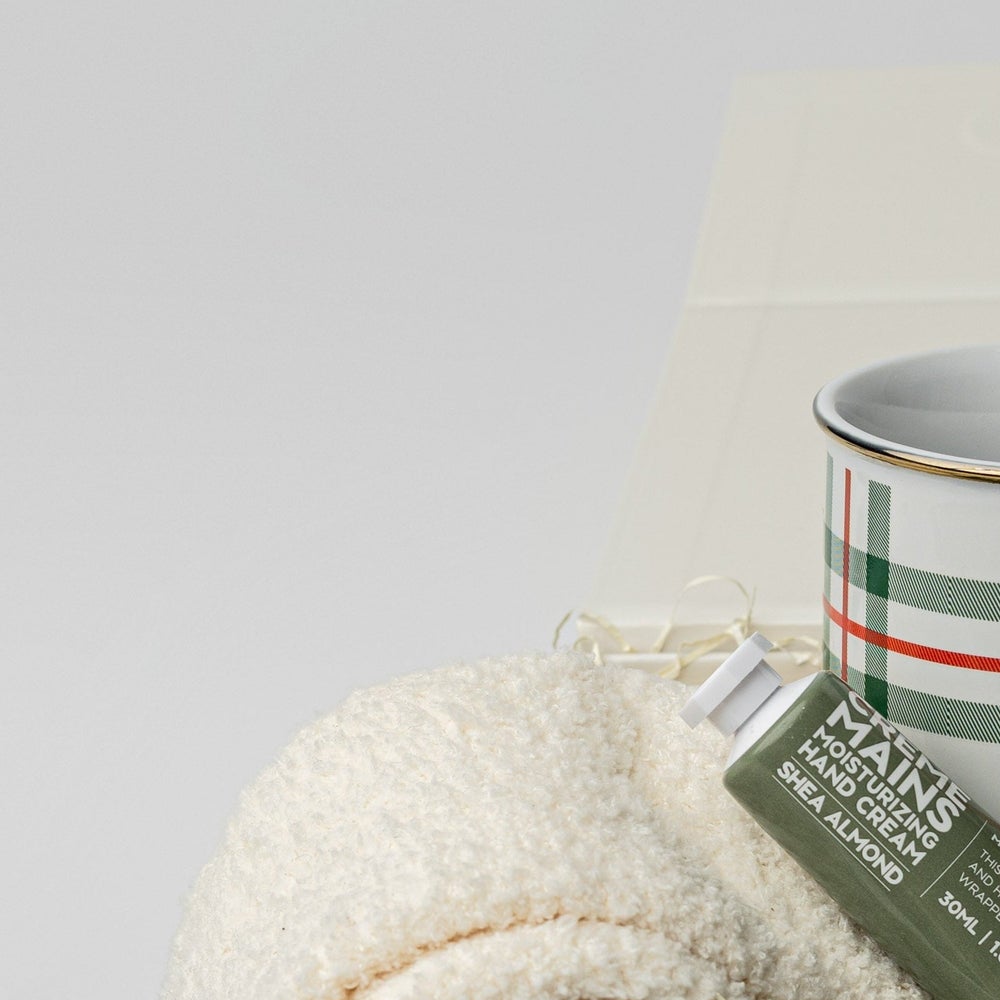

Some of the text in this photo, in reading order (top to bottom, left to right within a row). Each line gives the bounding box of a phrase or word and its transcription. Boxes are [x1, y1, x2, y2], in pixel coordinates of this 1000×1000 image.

[776, 761, 904, 885] SHEA ALMOND
[797, 739, 927, 866] HAND CREAM
[812, 725, 939, 850] MOISTURIZING
[826, 700, 960, 833] MAINS
[938, 890, 979, 936] 30ML
[968, 862, 994, 887] AND
